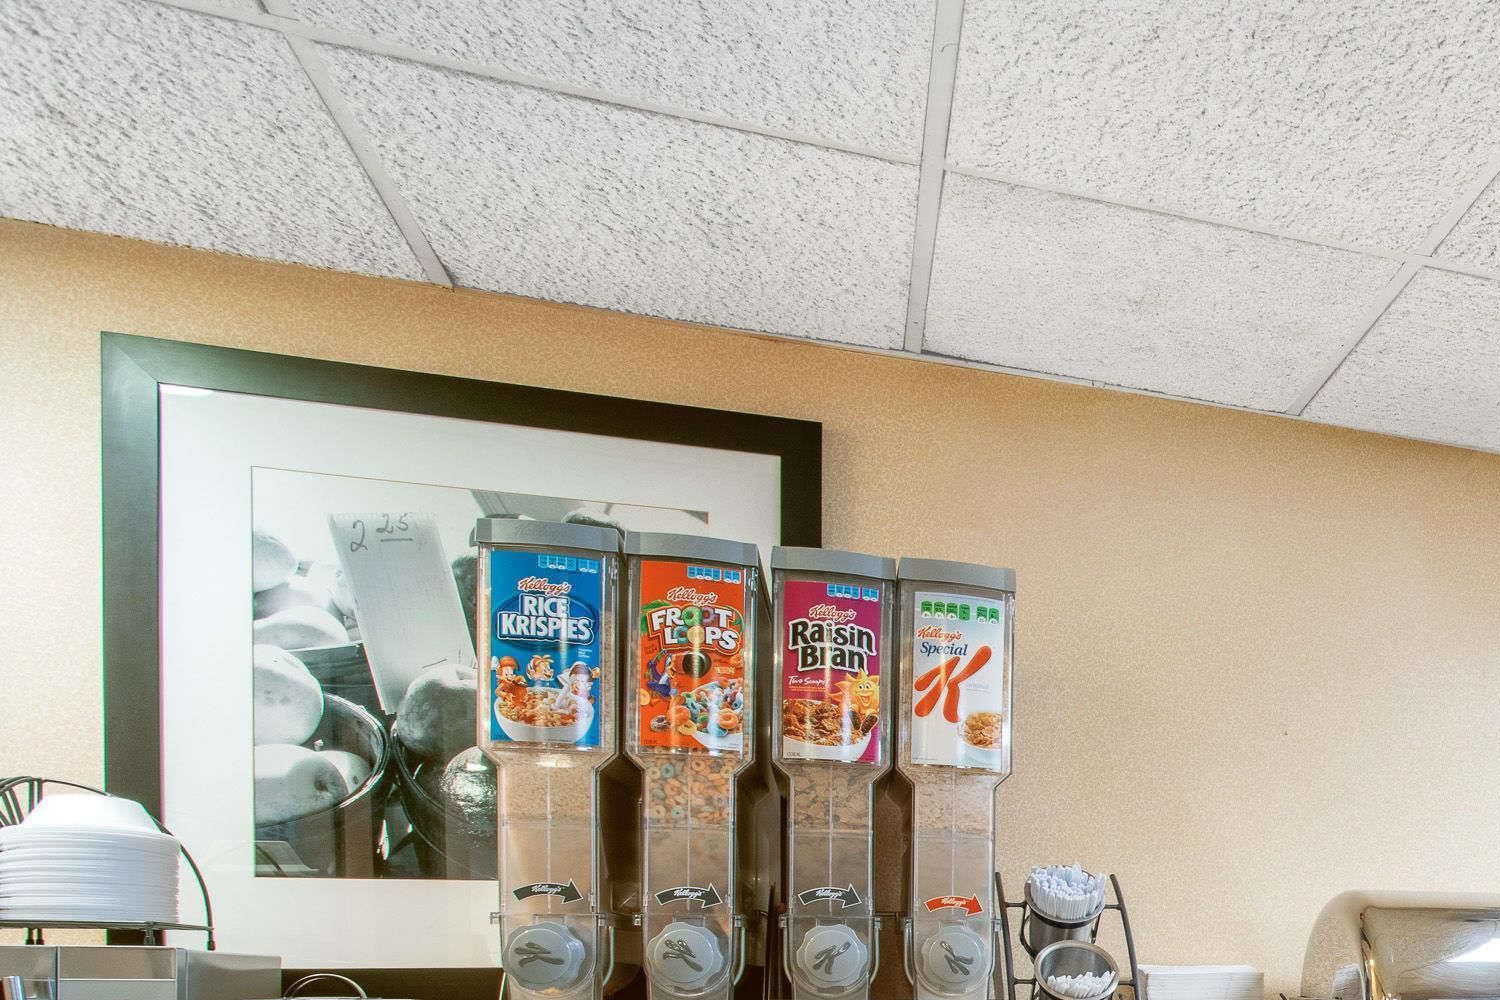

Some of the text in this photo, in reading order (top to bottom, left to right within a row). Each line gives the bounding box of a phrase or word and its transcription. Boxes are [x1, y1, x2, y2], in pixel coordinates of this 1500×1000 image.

[518, 576, 571, 595] Kellogg's
[667, 587, 718, 605] Kellogg's
[522, 596, 569, 617] RICE
[809, 604, 857, 622] Kellogg's
[500, 613, 592, 640] KRISPIES
[652, 605, 733, 631] FROOT
[665, 626, 738, 650] LOOPS
[790, 620, 874, 653] Raisin
[917, 626, 961, 642] Kellogg's
[800, 644, 866, 670] Bran
[920, 642, 968, 656] Special
[914, 645, 992, 723] K
[531, 884, 563, 894] Kellogg's
[673, 888, 705, 898] Kellogg's
[816, 889, 843, 899] Kellogg's
